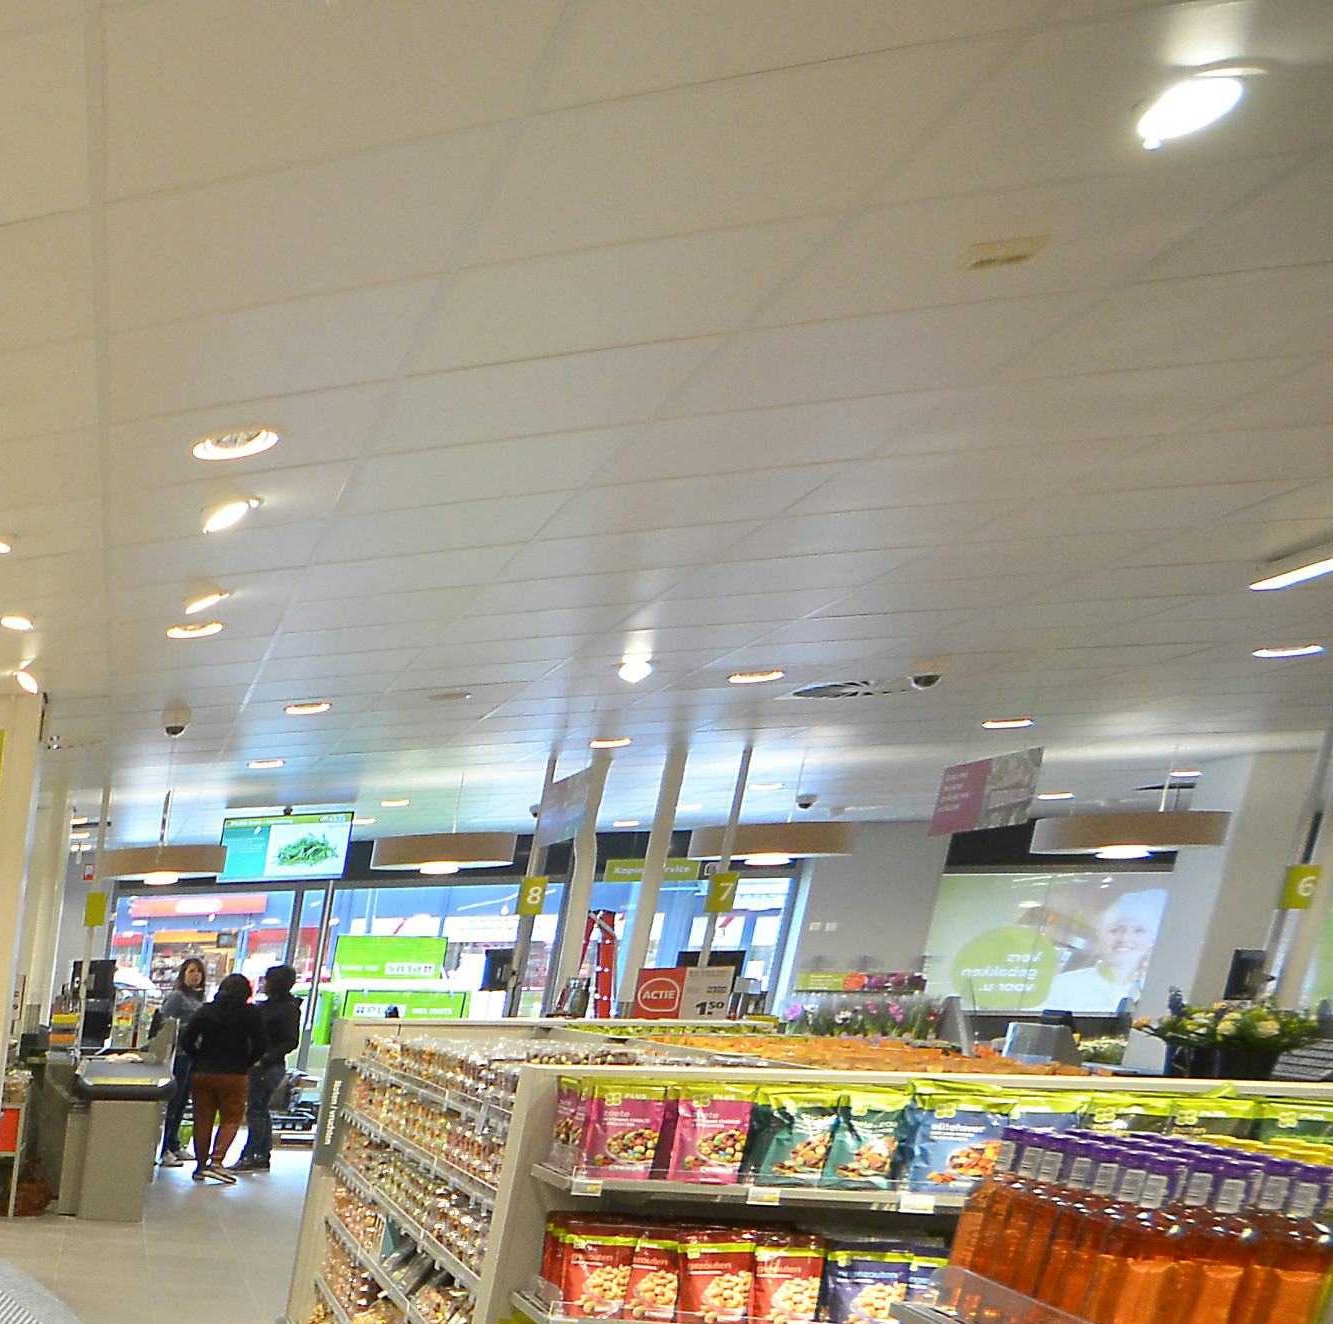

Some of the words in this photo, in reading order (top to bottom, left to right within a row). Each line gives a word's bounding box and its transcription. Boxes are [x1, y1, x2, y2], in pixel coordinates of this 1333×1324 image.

[720, 883, 733, 900] 7
[1297, 875, 1316, 896] 6
[526, 887, 542, 904] 8
[642, 990, 676, 999] ACTIE
